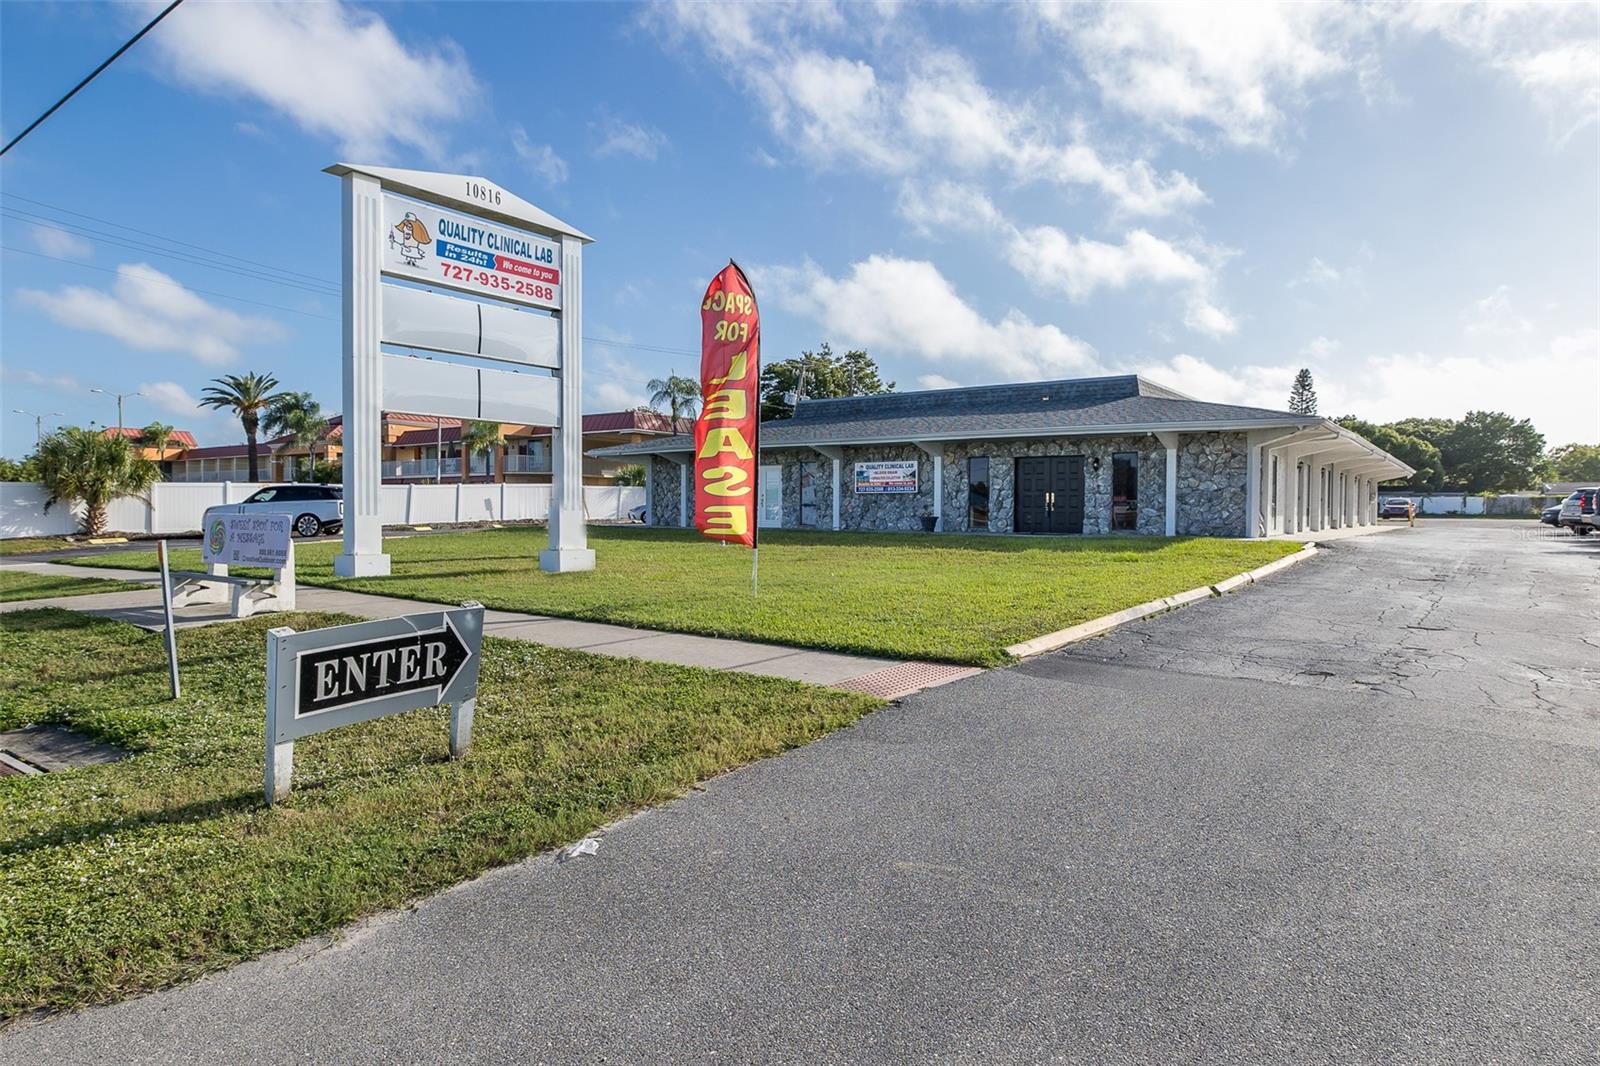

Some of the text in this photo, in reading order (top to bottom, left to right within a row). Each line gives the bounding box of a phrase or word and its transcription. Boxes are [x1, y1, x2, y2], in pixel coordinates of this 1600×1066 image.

[466, 182, 501, 205] 10816
[438, 218, 553, 263] QUALITY CLINICAL LAB
[446, 243, 489, 260] Results
[445, 250, 488, 267] in 24h!
[502, 260, 553, 280] We come to you
[440, 262, 554, 301] 727-935-2588
[313, 641, 448, 702] ENTER
